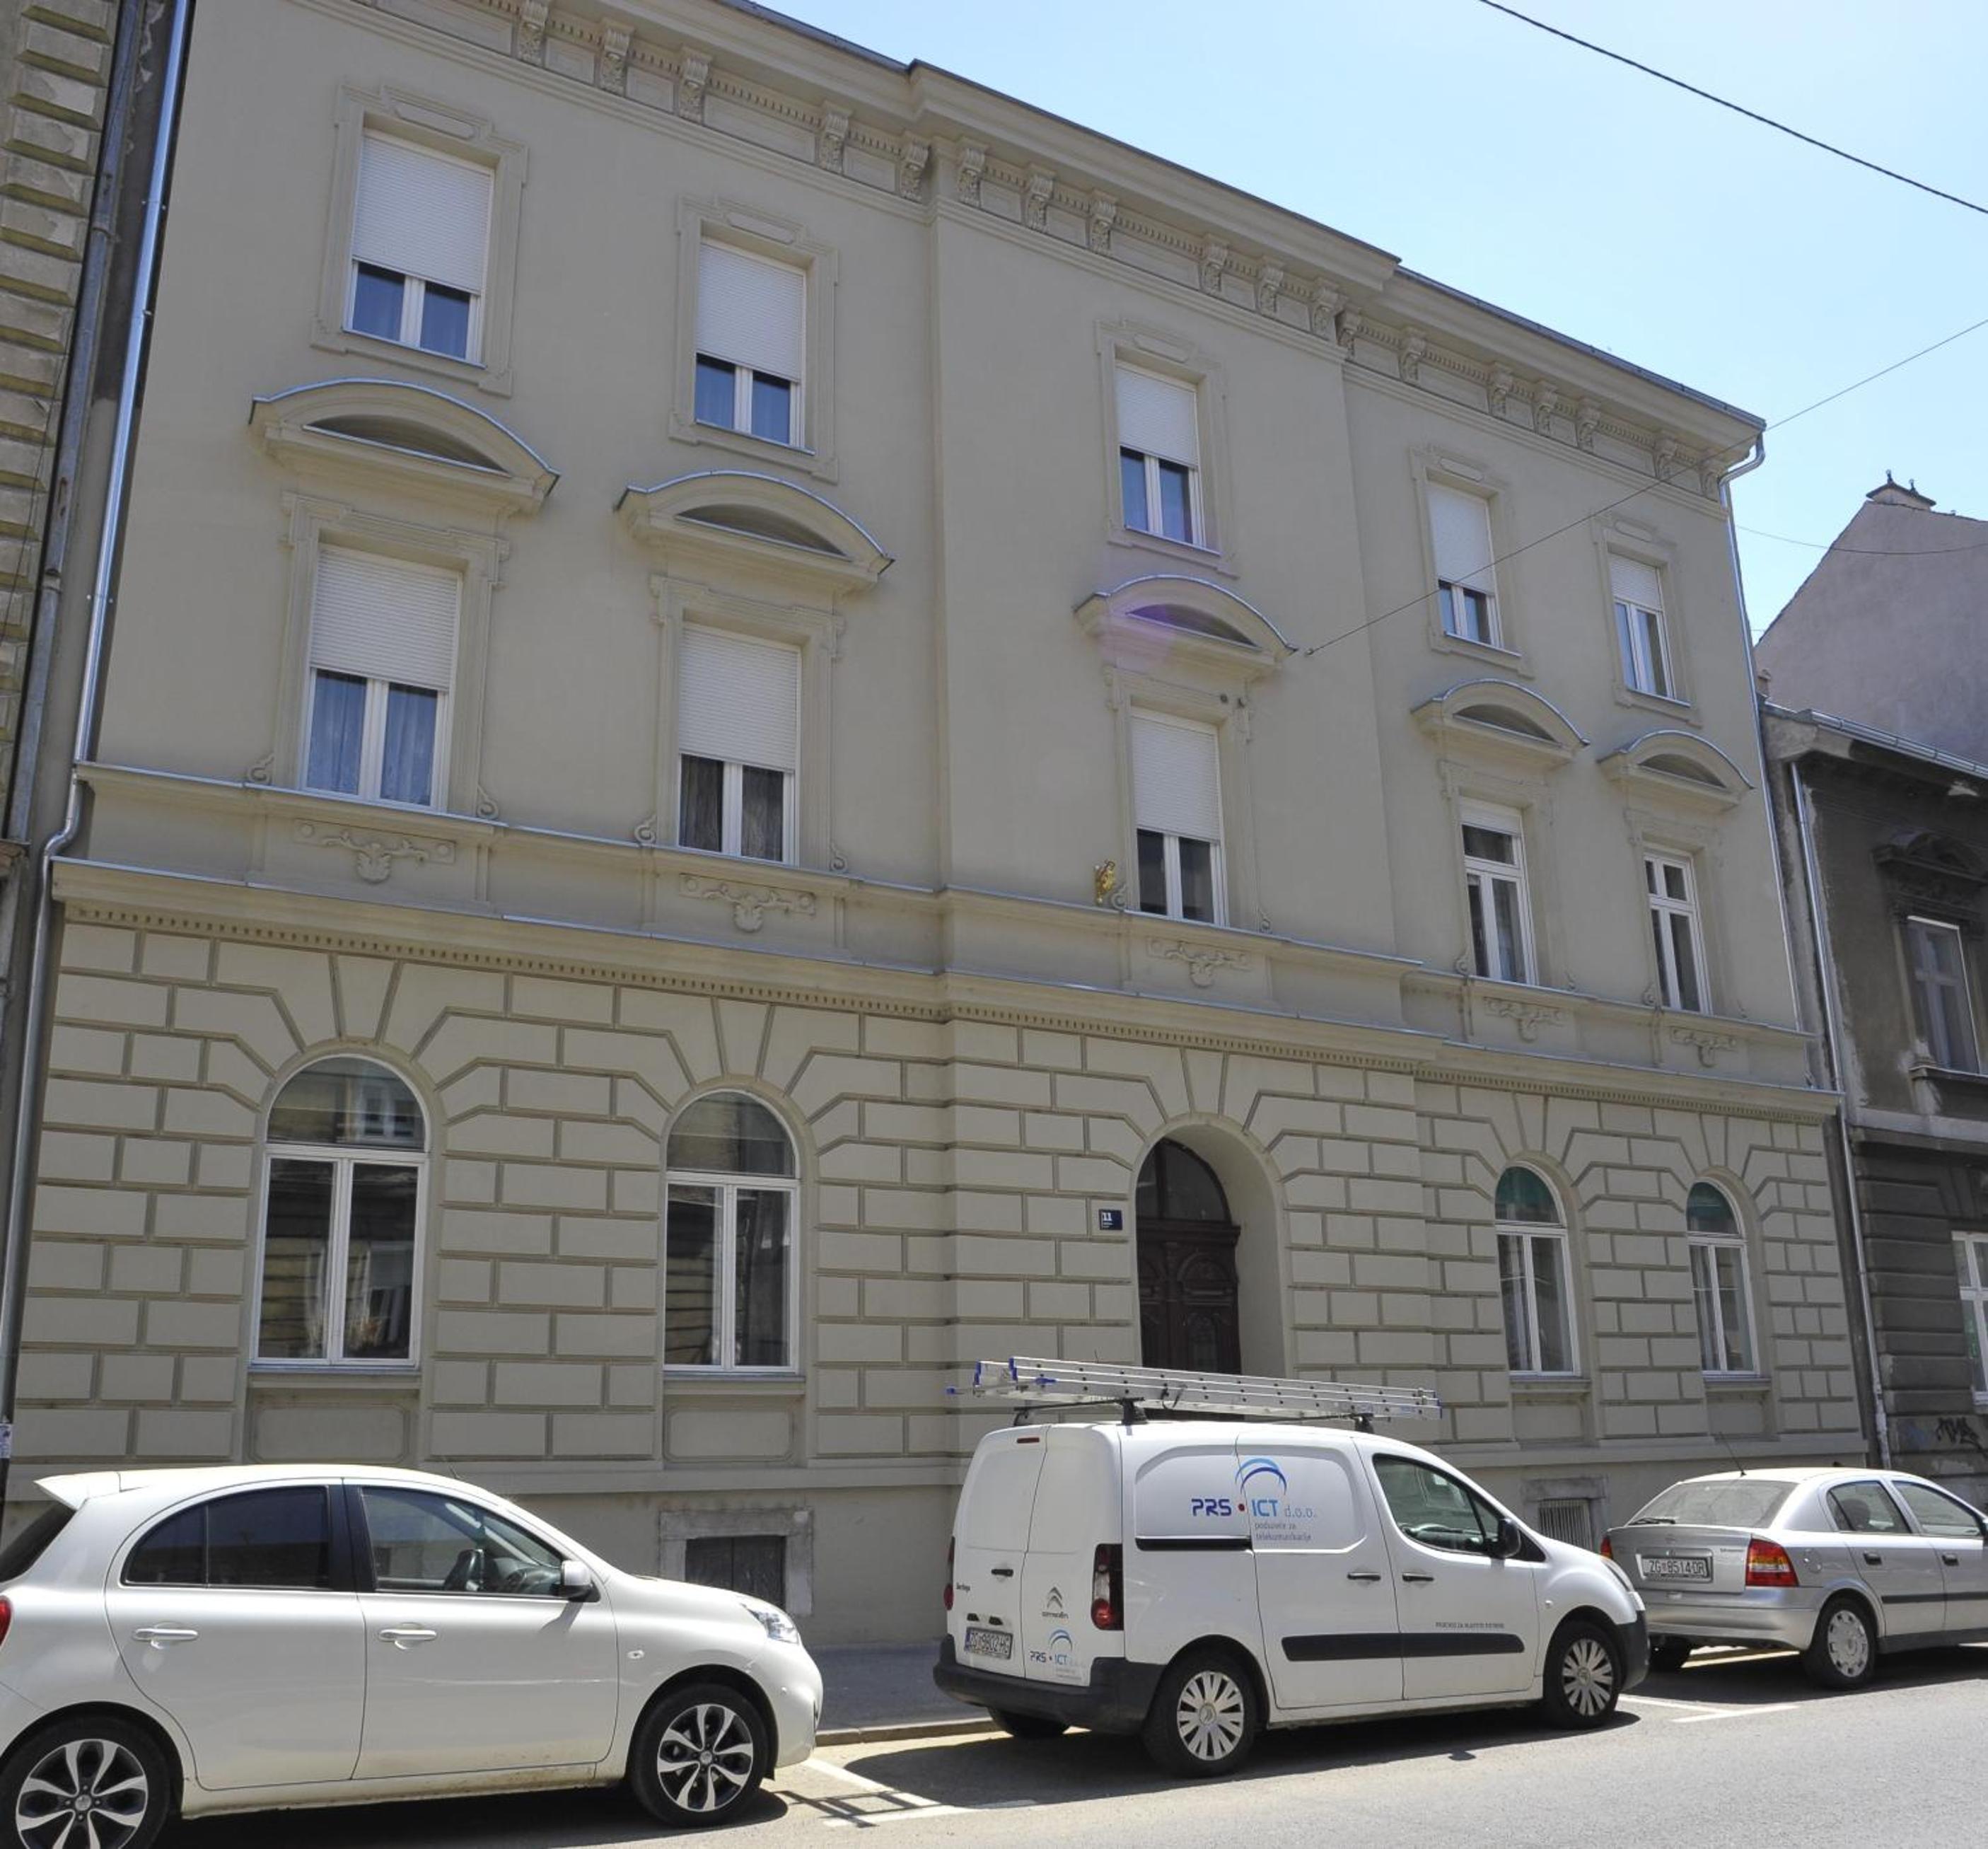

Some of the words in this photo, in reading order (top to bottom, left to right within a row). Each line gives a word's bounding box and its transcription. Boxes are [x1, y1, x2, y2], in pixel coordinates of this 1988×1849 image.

[1191, 1498, 1232, 1517] PRS
[1251, 1500, 1278, 1517] ICT
[1030, 1651, 1047, 1663] PRS
